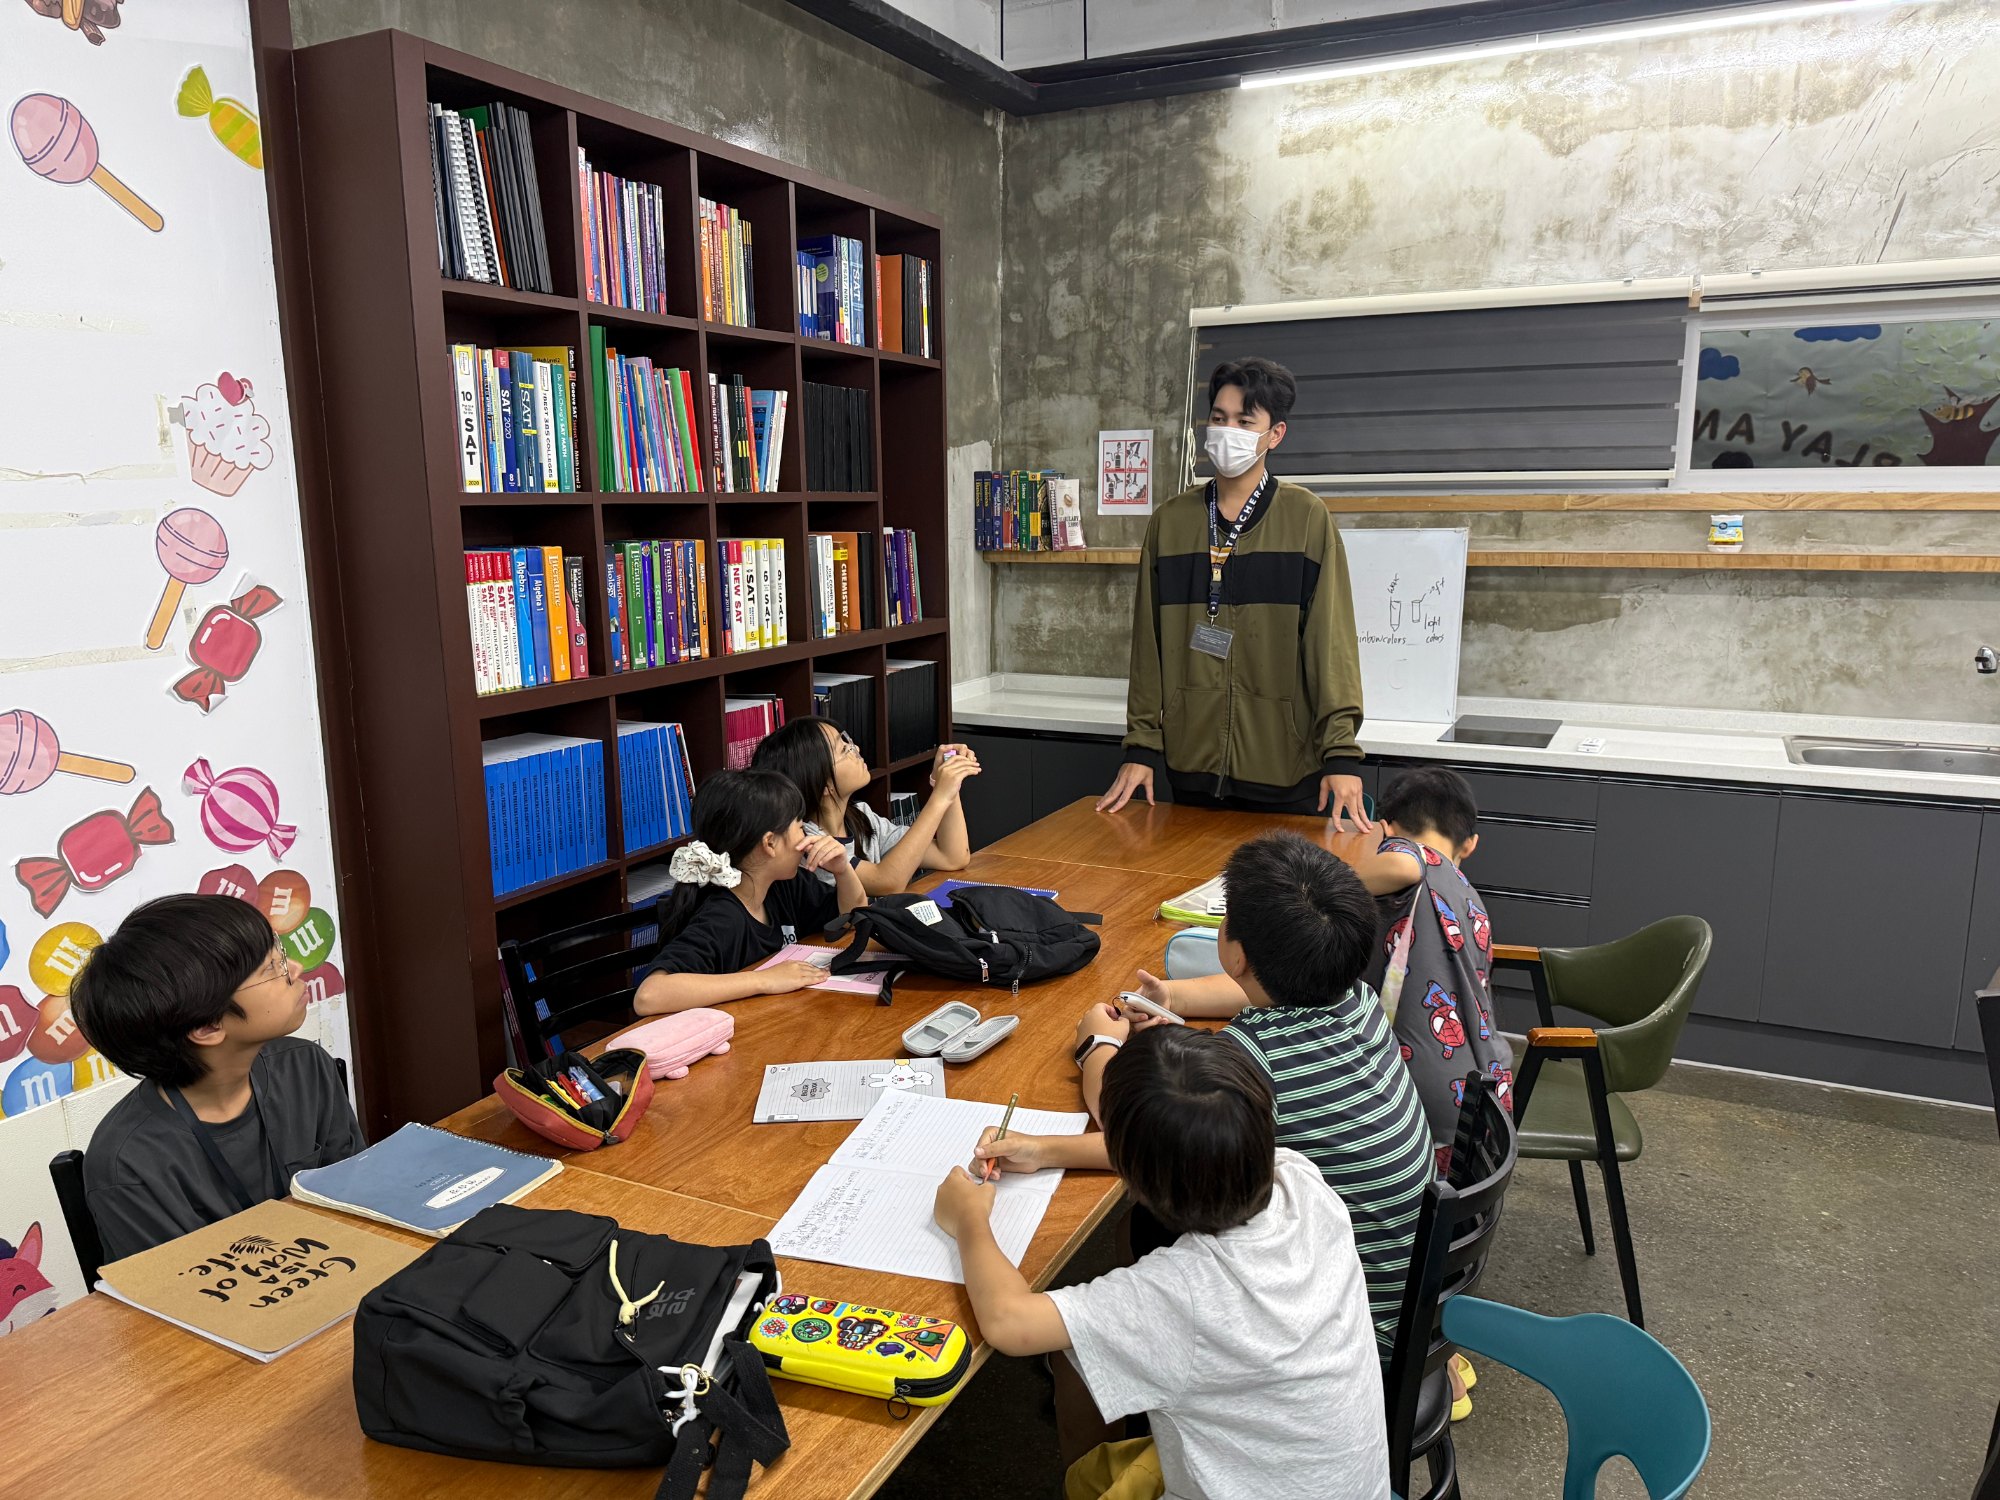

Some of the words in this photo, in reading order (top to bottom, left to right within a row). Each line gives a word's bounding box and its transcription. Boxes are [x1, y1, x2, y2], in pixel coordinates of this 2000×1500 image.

[462, 391, 472, 402] 10
[522, 389, 532, 428] SAT
[466, 418, 476, 466] SAT
[1226, 490, 1261, 547] TEACHER
[517, 562, 528, 591] Algebra
[549, 555, 561, 607] Literature
[607, 563, 615, 598] Biology
[632, 549, 642, 598] Literature
[664, 547, 673, 594] Literature
[764, 571, 768, 582] 6
[778, 570, 782, 581] 9
[498, 586, 506, 609] SAT
[532, 579, 543, 606] Algebra
[1424, 613, 1440, 633] light
[270, 887, 293, 916] m
[289, 919, 325, 957] m
[45, 936, 90, 976] m
[306, 976, 326, 1006] m
[45, 1009, 76, 1046] m
[21, 1070, 60, 1110] m
[241, 1238, 330, 1277] Way
[280, 1262, 308, 1275] is
[198, 1278, 238, 1302] of
[249, 1256, 356, 1308] Green
[258, 1274, 280, 1284] A
